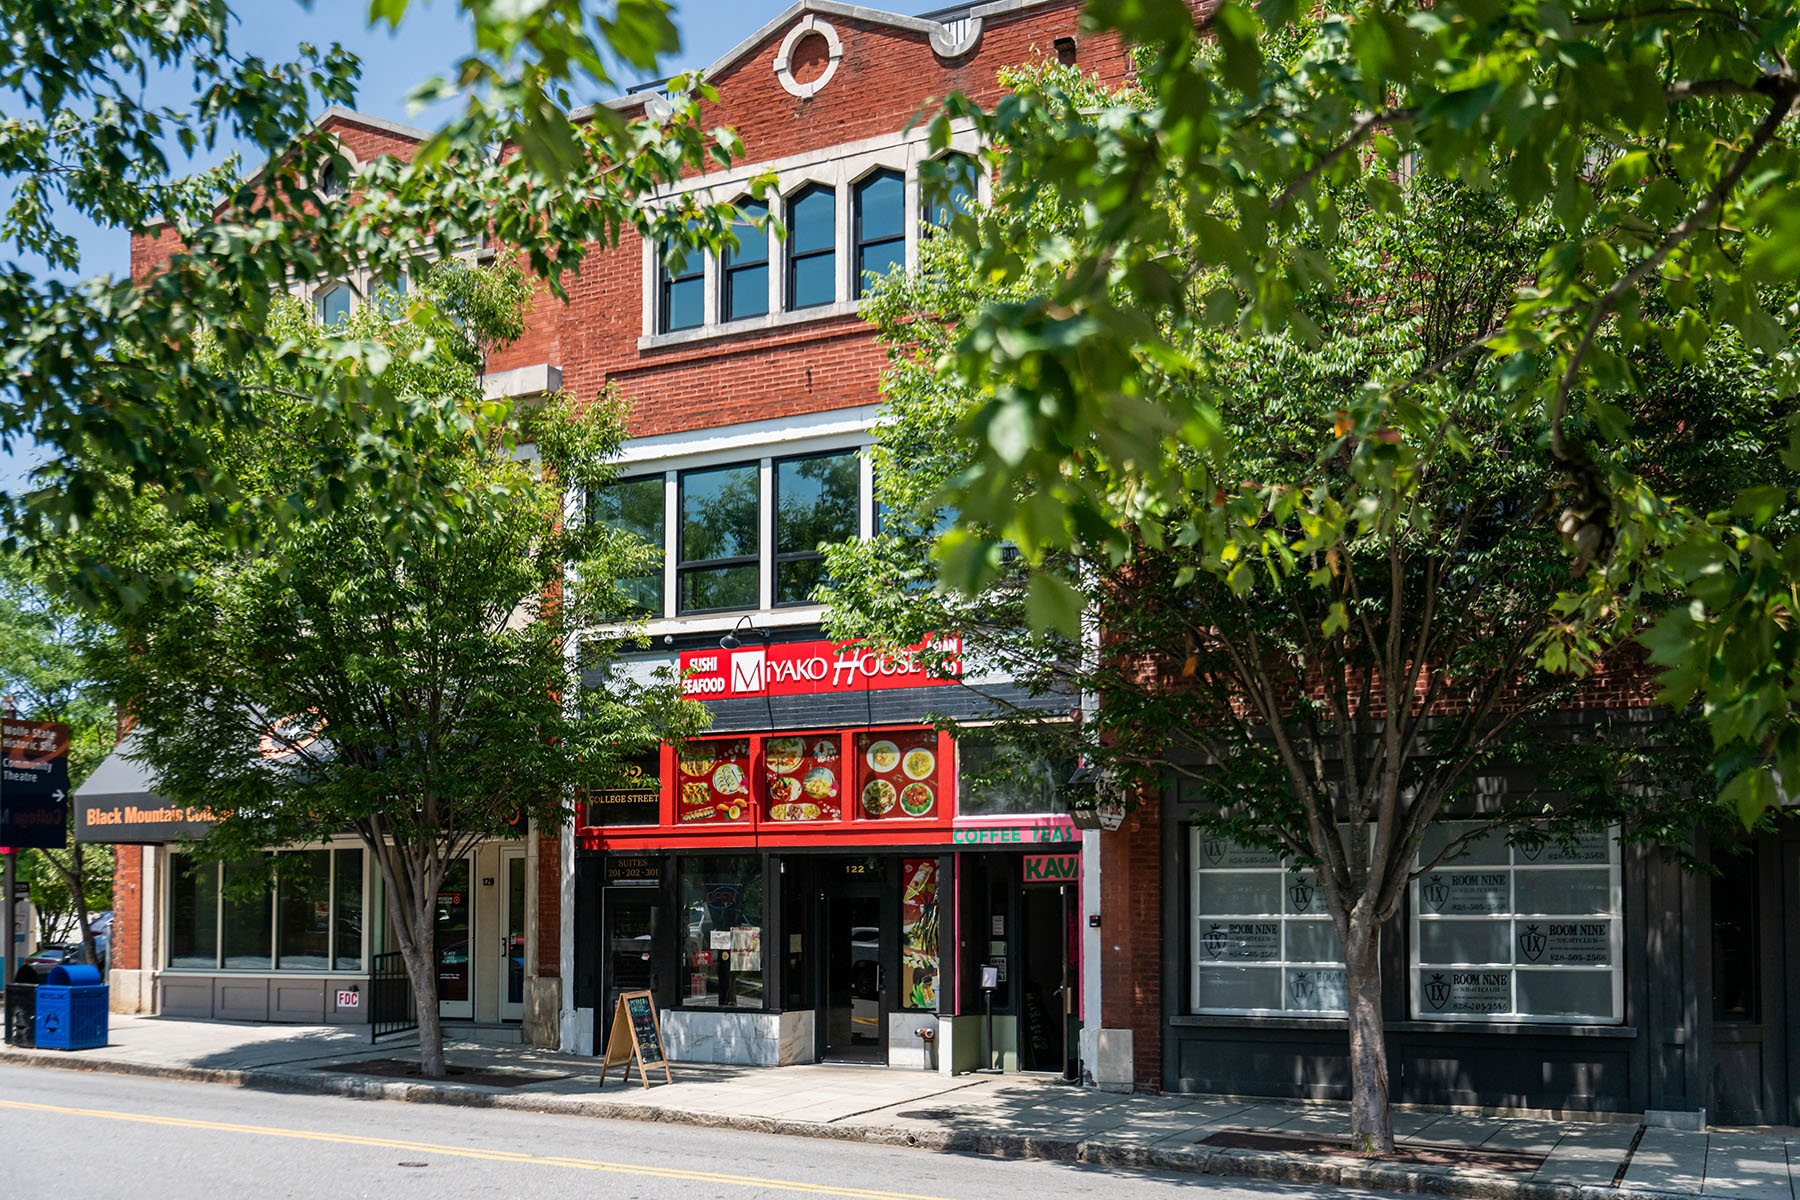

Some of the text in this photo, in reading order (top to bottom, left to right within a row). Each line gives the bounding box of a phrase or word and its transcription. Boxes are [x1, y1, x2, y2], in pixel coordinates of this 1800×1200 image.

[689, 656, 718, 672] SUSHI
[832, 645, 921, 686] HOUSE
[682, 677, 726, 695] SEAFOOD
[3, 770, 38, 782] Theatre
[588, 793, 660, 804] COLLEGE STREET
[86, 807, 123, 826] Black
[124, 804, 184, 824] Mountain
[953, 825, 1073, 844] COFFEE TEAS
[1209, 841, 1222, 857] IX
[618, 858, 649, 867] SUITES
[845, 865, 865, 873] 122
[608, 867, 659, 877] 201 202 301
[1452, 874, 1506, 886] ROOM NINE
[1295, 888, 1308, 903] IX
[1430, 886, 1443, 902] IX
[1229, 923, 1278, 934] ROOM NINE
[1549, 924, 1606, 936] ROOM NINE
[1209, 935, 1222, 949] IX
[1527, 936, 1540, 951] IX
[1453, 974, 1507, 986] ROOM NINE
[338, 992, 358, 1005] FDC
[1431, 985, 1444, 1001] IX
